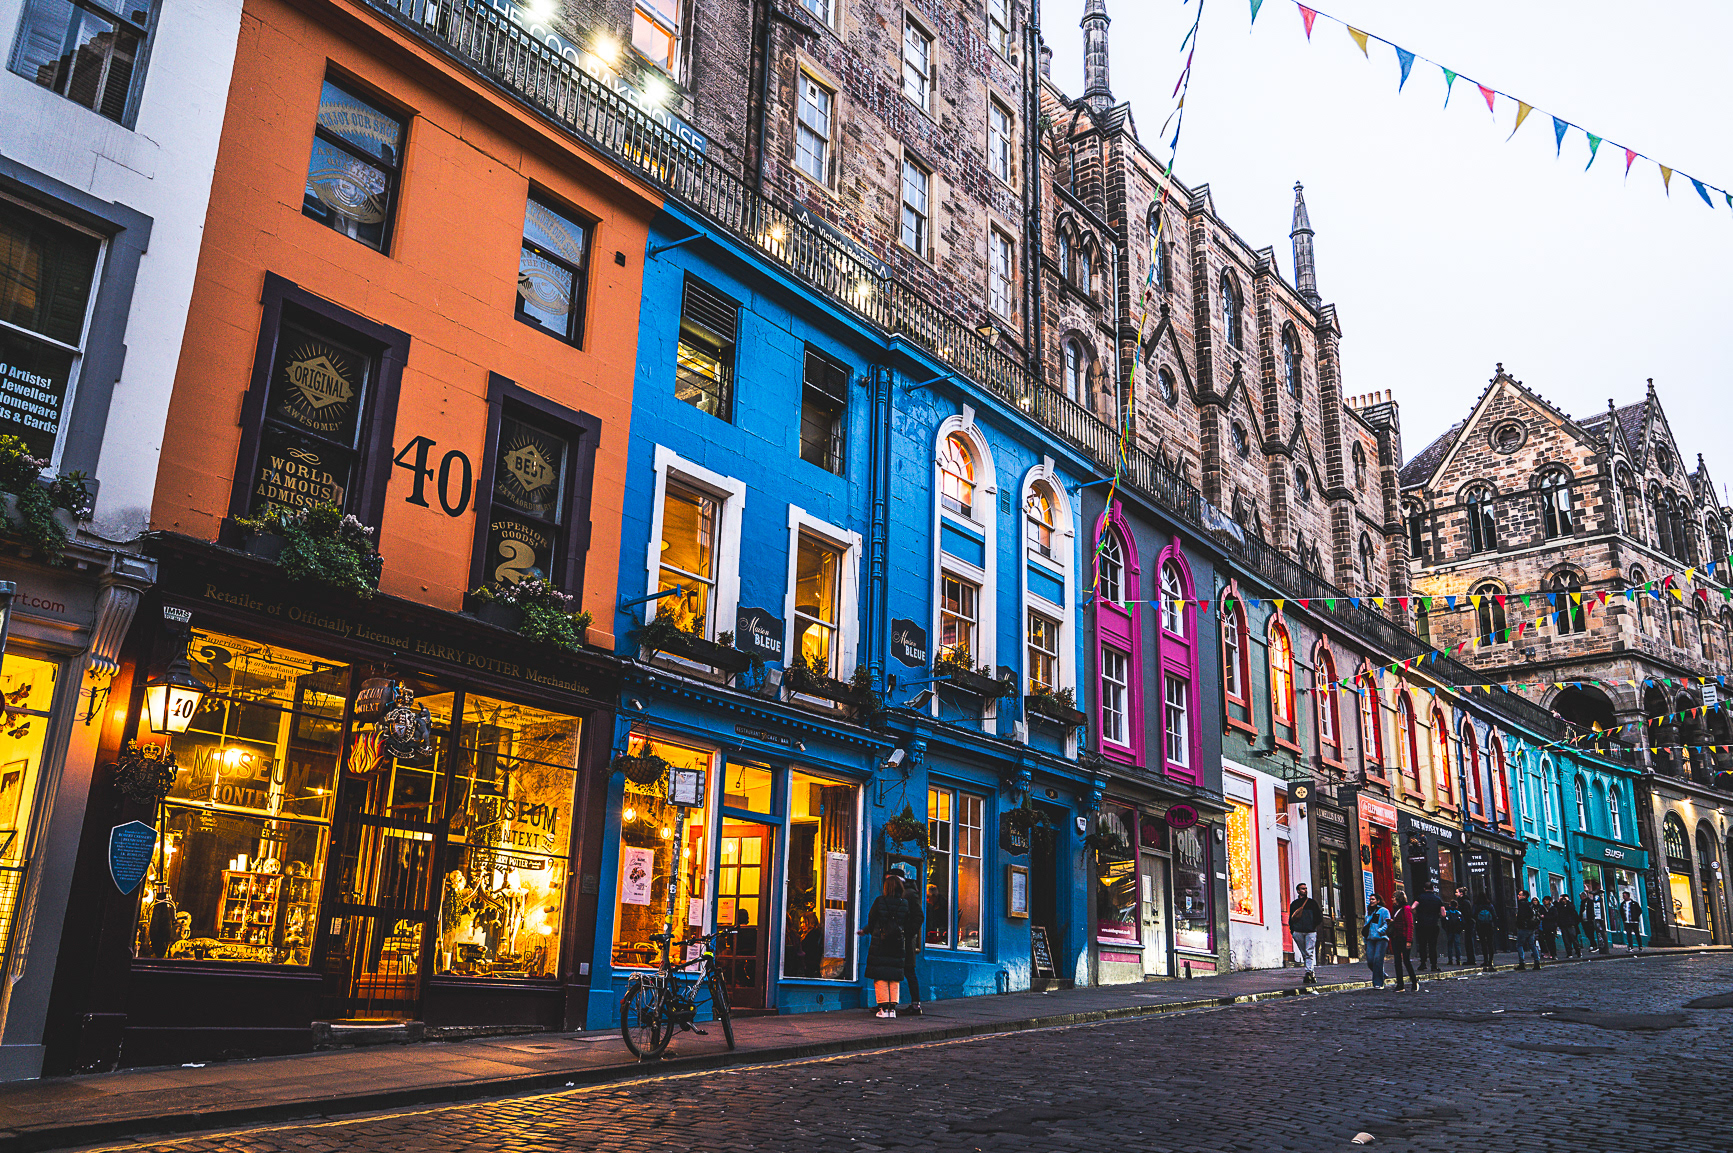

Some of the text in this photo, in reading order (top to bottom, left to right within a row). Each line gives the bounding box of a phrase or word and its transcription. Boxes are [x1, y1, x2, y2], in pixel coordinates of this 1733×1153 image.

[319, 111, 399, 142] ENJOY OUR SHOP
[317, 146, 334, 158] AN
[552, 223, 566, 245] OUR
[818, 225, 846, 252] Victoria
[522, 258, 538, 269] THE
[8, 365, 52, 390] Artists!
[294, 365, 345, 400] ORIGINAL
[1, 377, 58, 408] Jewellery,
[13, 412, 22, 423] &
[23, 414, 58, 434] Cards
[271, 455, 333, 486] WORLD
[393, 435, 472, 518] 40
[515, 455, 546, 480] BEST
[260, 467, 332, 500] FAMOUS
[491, 521, 548, 548] SUPERIOR
[501, 530, 540, 549] GOODS!
[204, 583, 590, 695] Retailer of Officially Licensed HARRY POTTER Merchandise
[754, 632, 782, 653] BLEUE
[905, 644, 926, 662] BLEUE
[171, 698, 194, 719] 40
[190, 744, 312, 796] MUSEUM
[503, 828, 540, 848] NTEXT
[1410, 817, 1453, 840] THE WHISKY SHOP
[1604, 848, 1625, 860] SWISH
